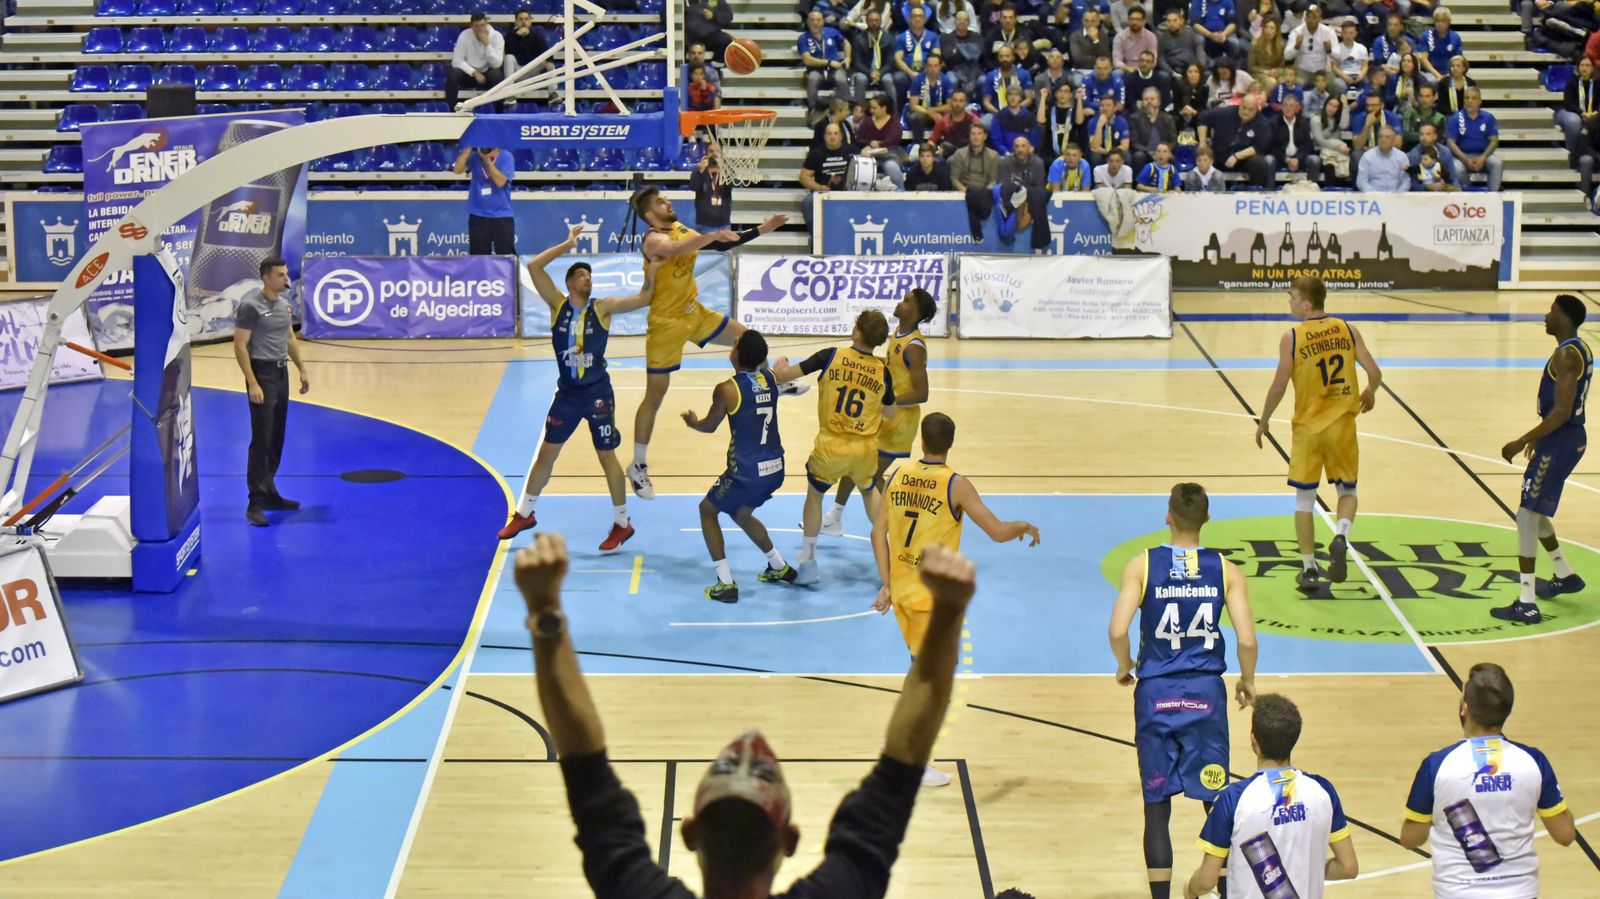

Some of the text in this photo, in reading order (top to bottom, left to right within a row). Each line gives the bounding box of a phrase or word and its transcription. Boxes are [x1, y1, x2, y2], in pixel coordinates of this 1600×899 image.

[129, 150, 197, 167] ENER
[1235, 196, 1382, 216] PEÑA UDEISTA
[1463, 203, 1487, 219] ice
[82, 259, 104, 283] ACE
[792, 258, 944, 276] COPISTERIA
[1252, 269, 1362, 280] NI UN PASO ATRAS
[380, 275, 506, 303] populares
[790, 274, 944, 302] COPISERVI
[1066, 276, 1134, 286] Javier Romero
[327, 288, 364, 314] PP
[390, 300, 503, 321] de Algeciras
[754, 306, 838, 317] www.copiservi.com
[793, 324, 811, 334] 956
[831, 324, 848, 333] 876
[1299, 337, 1351, 360] STEINBERGS
[1315, 353, 1345, 387] 12
[829, 368, 884, 395] DE LA TORRE
[834, 386, 867, 419] 16
[598, 424, 612, 437] 10
[756, 406, 774, 445] 7
[904, 510, 919, 548] 7
[1155, 584, 1218, 599] Kaliničenko
[1155, 602, 1220, 650] 44
[1481, 775, 1512, 785] ENER
